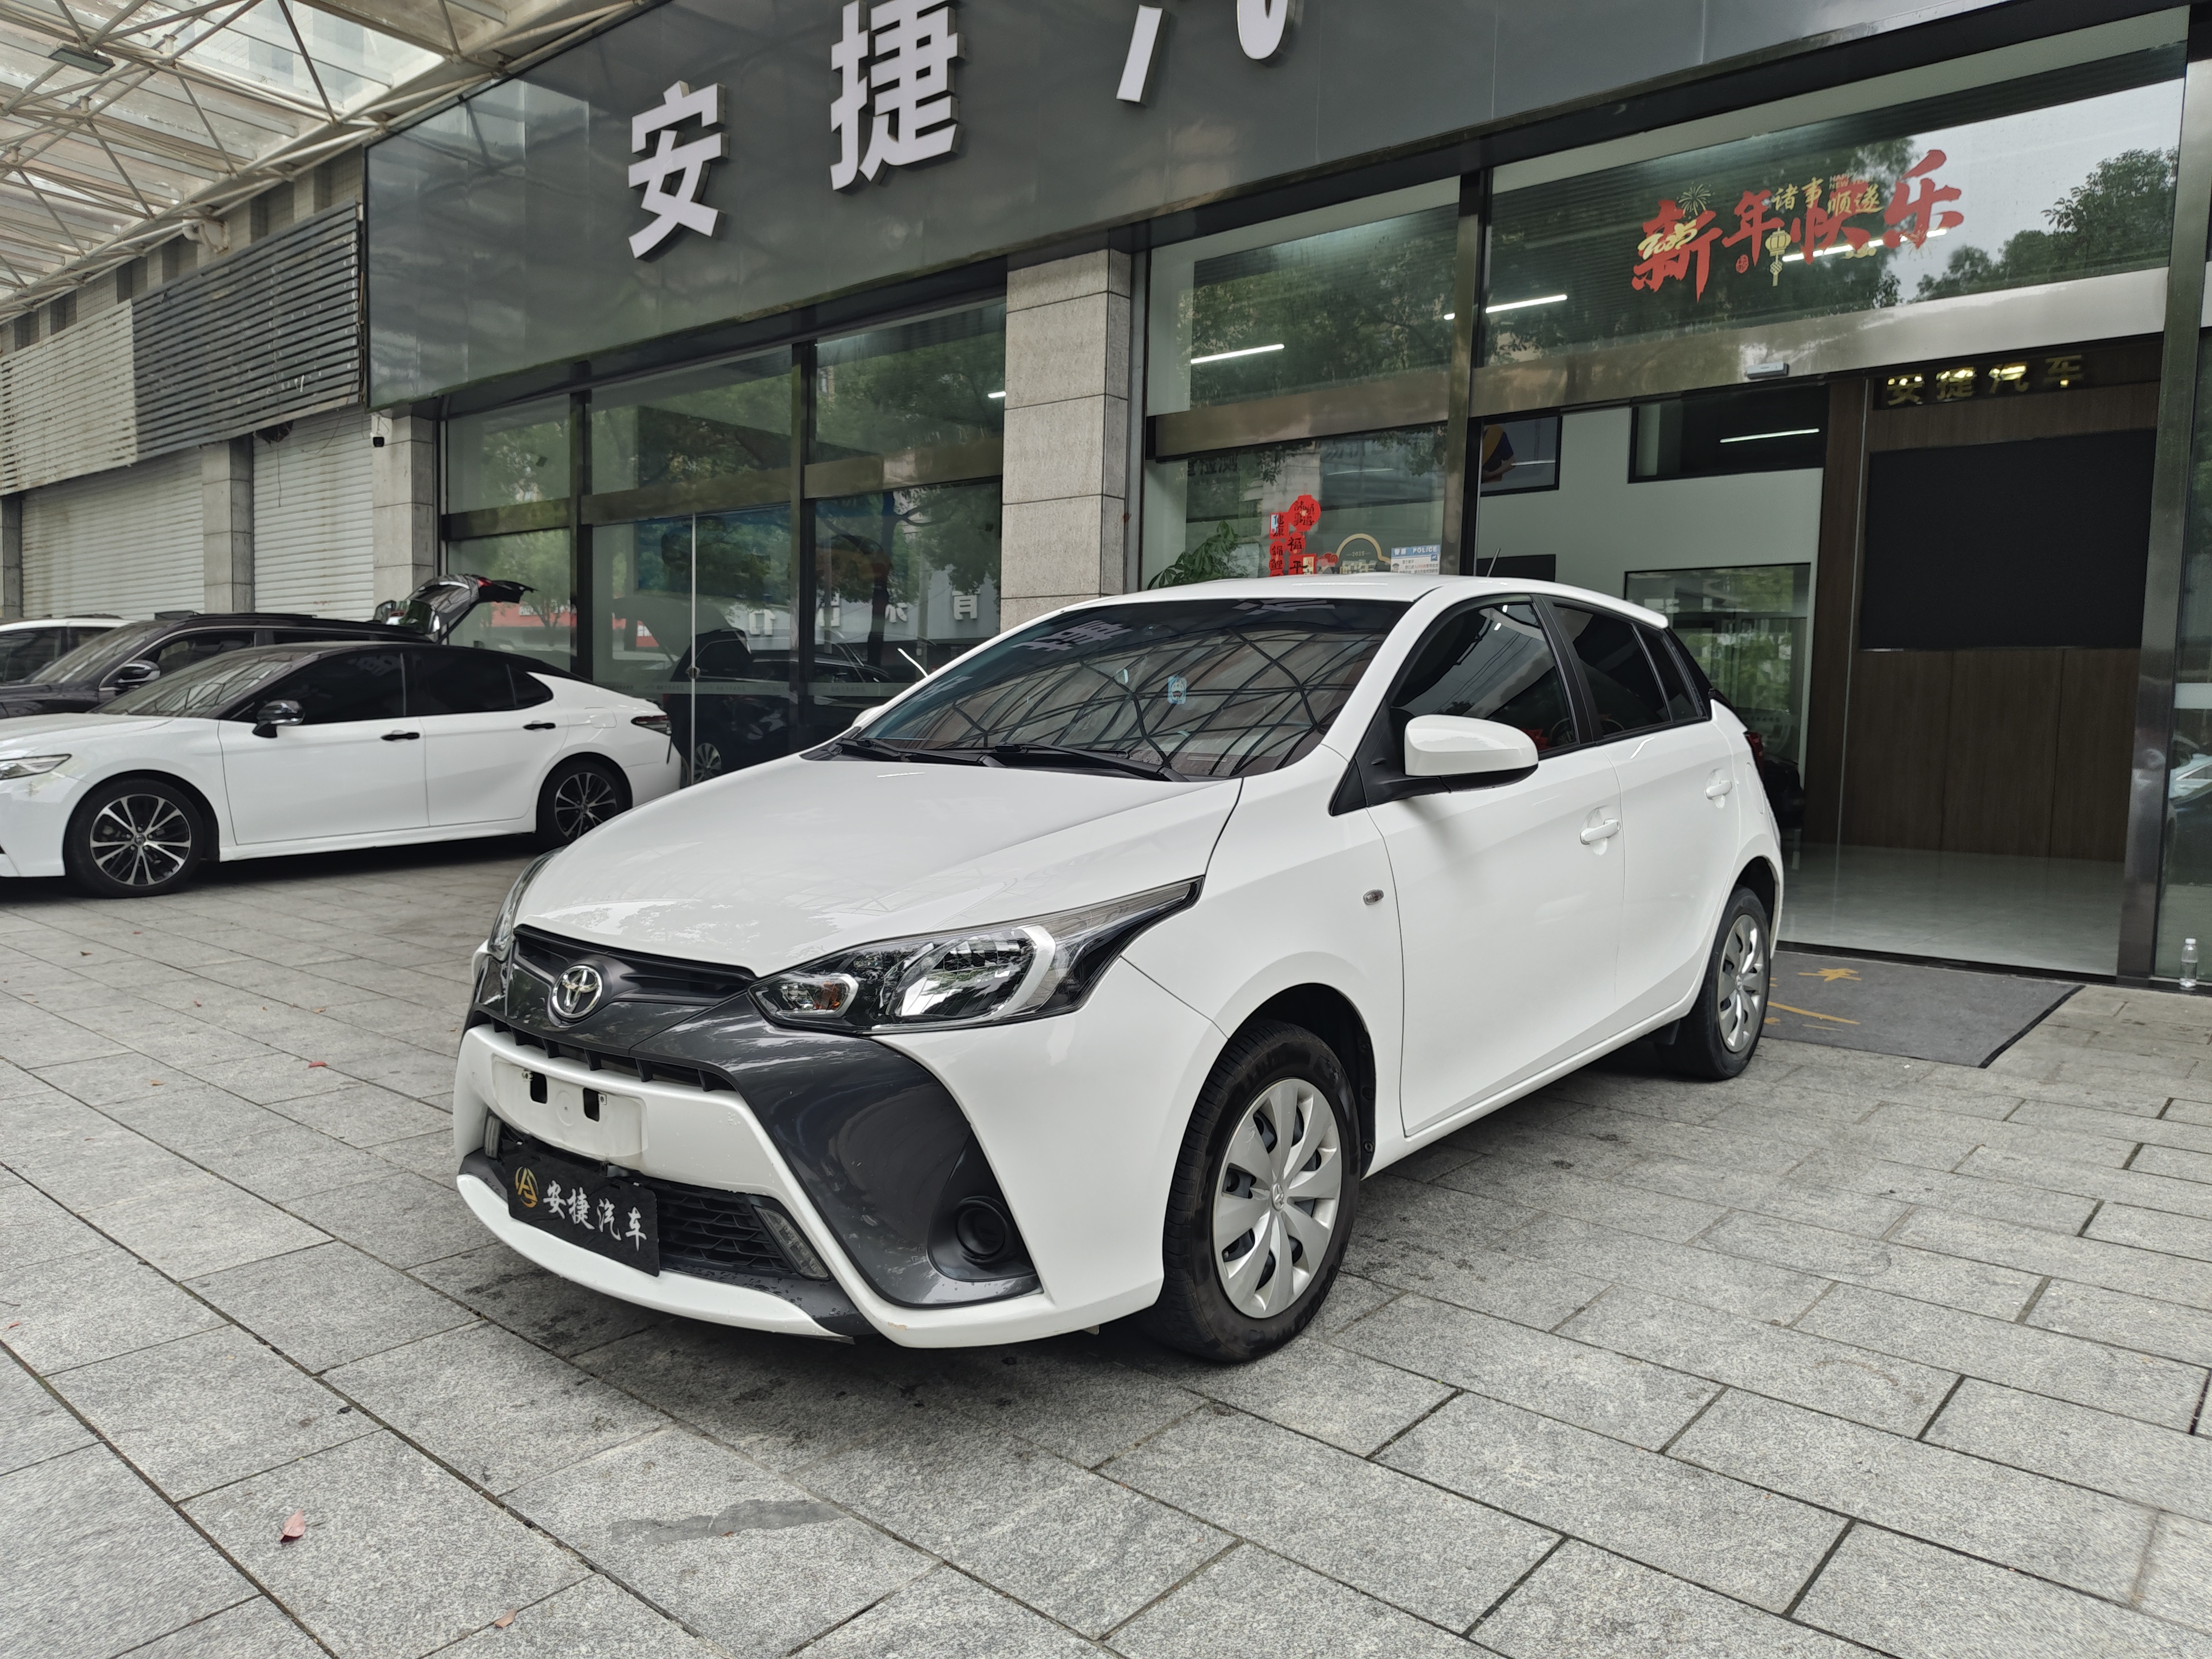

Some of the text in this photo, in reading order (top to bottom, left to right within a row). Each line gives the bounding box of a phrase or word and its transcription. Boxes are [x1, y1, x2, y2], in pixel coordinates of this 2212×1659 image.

[1631, 149, 1964, 303] 新年快乐
[1886, 354, 2083, 407] 安捷汽车
[1412, 545, 1437, 554] POLICE
[543, 1180, 647, 1250] 安捷汽车
